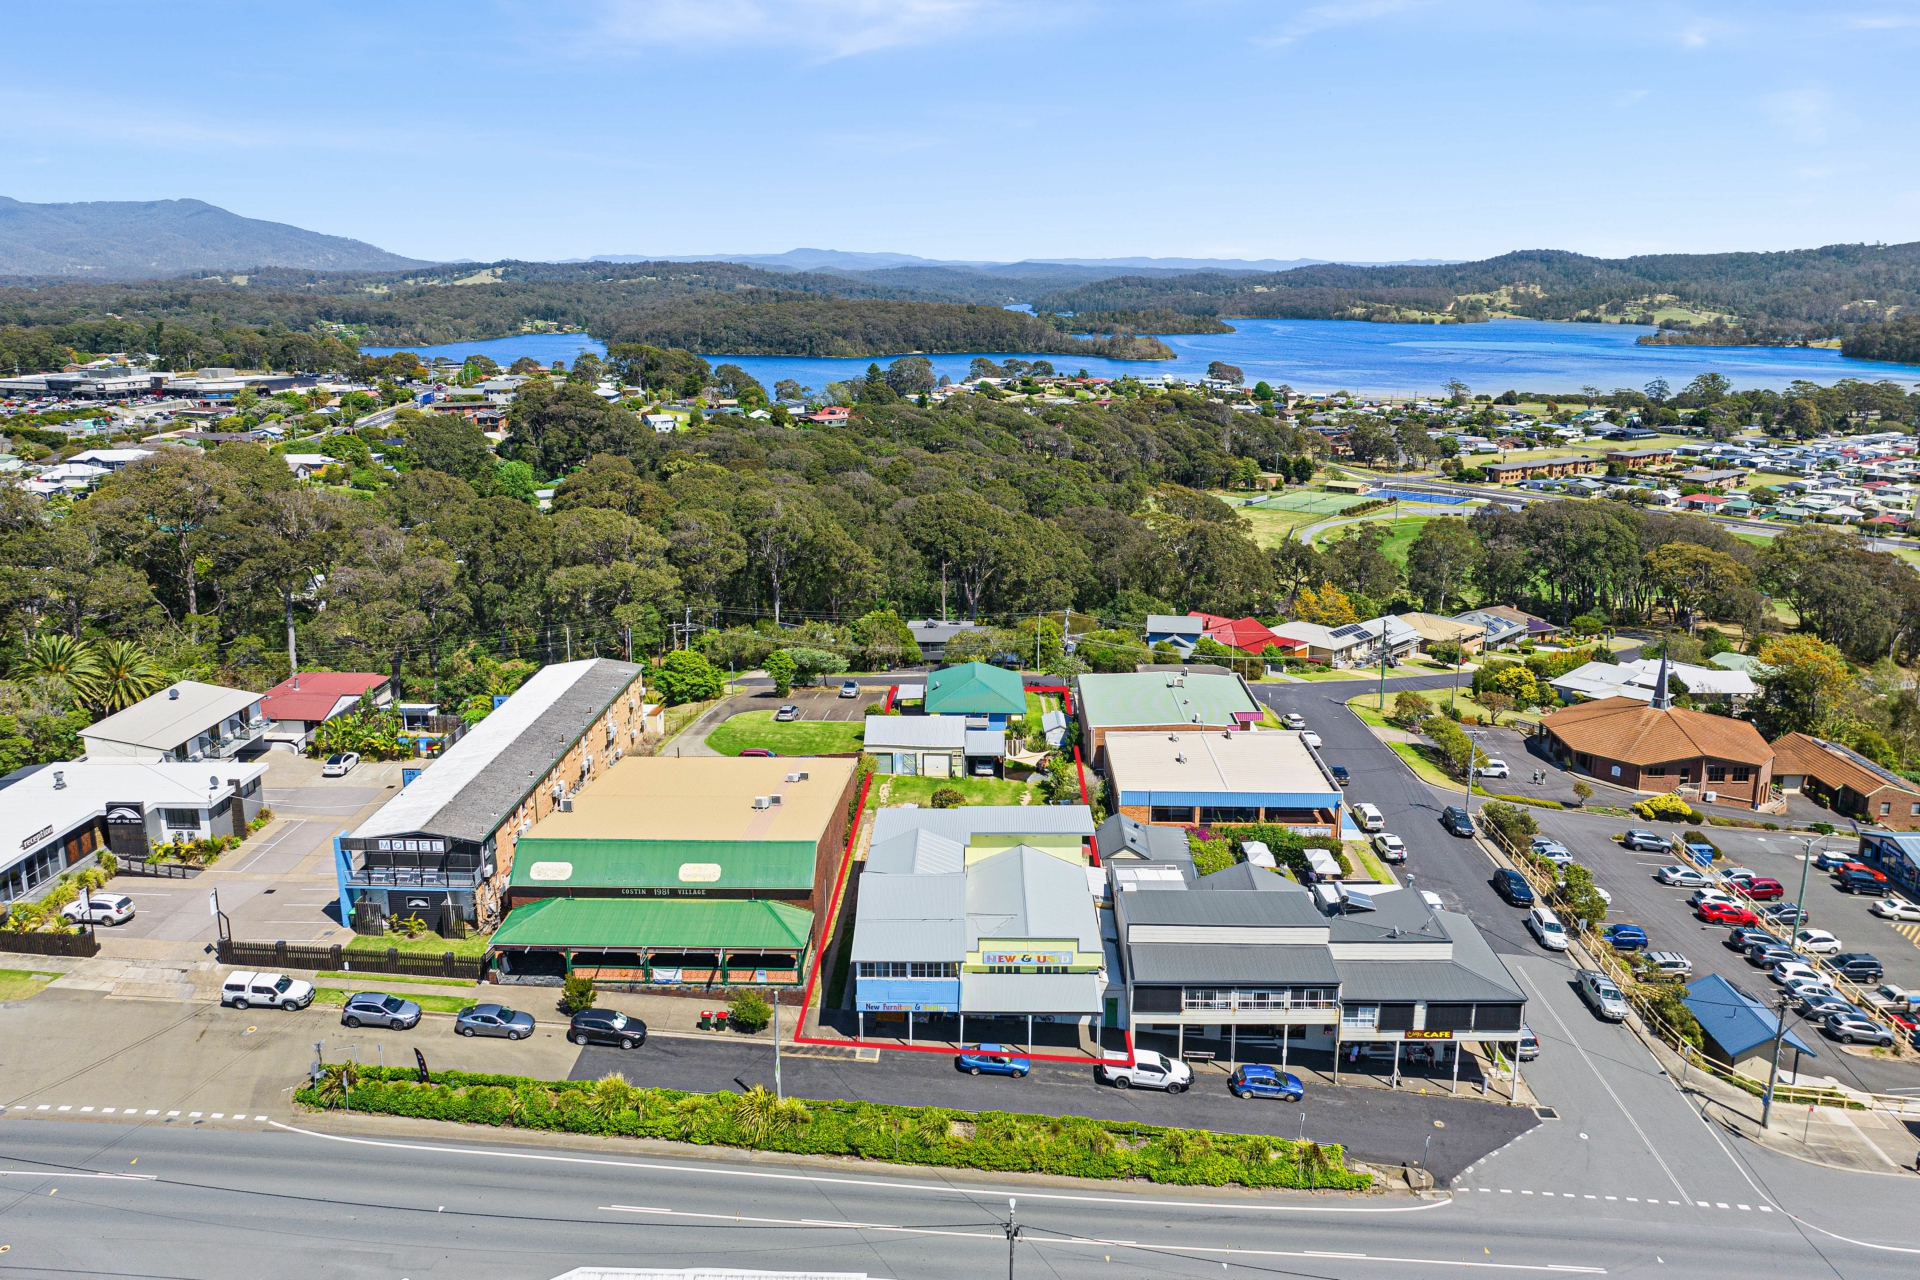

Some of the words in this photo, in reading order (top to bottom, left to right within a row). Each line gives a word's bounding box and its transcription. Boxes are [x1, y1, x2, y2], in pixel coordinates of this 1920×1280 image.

[23, 827, 53, 848] reception
[380, 841, 442, 851] MOTEL
[654, 888, 670, 896] 1981
[986, 955, 1016, 963] NEW
[1020, 954, 1032, 963] &
[1036, 955, 1070, 964] USED
[865, 1003, 880, 1011] New
[882, 1003, 912, 1011] Furniture
[914, 1003, 921, 1011] &
